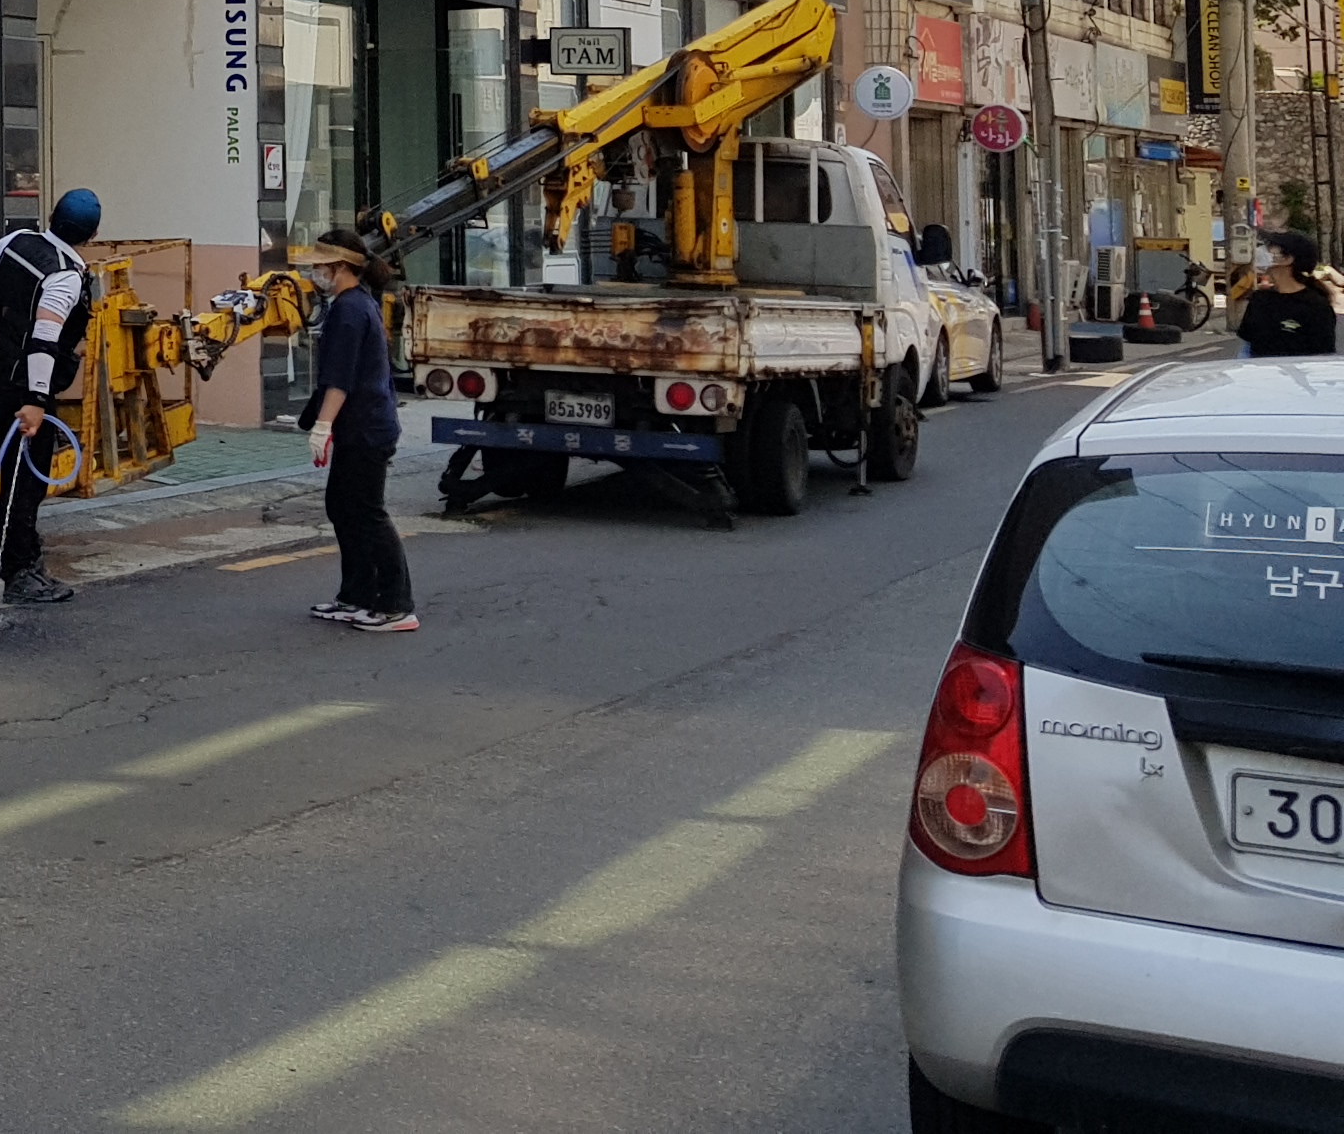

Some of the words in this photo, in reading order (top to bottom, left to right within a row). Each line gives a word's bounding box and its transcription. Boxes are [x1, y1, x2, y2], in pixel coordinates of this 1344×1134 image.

[562, 47, 615, 65] TAM
[578, 37, 600, 46] Nail
[226, 107, 240, 165] PALACE
[1266, 566, 1344, 600] 남구
[1039, 717, 1162, 750] morning
[1267, 788, 1343, 845] 30
